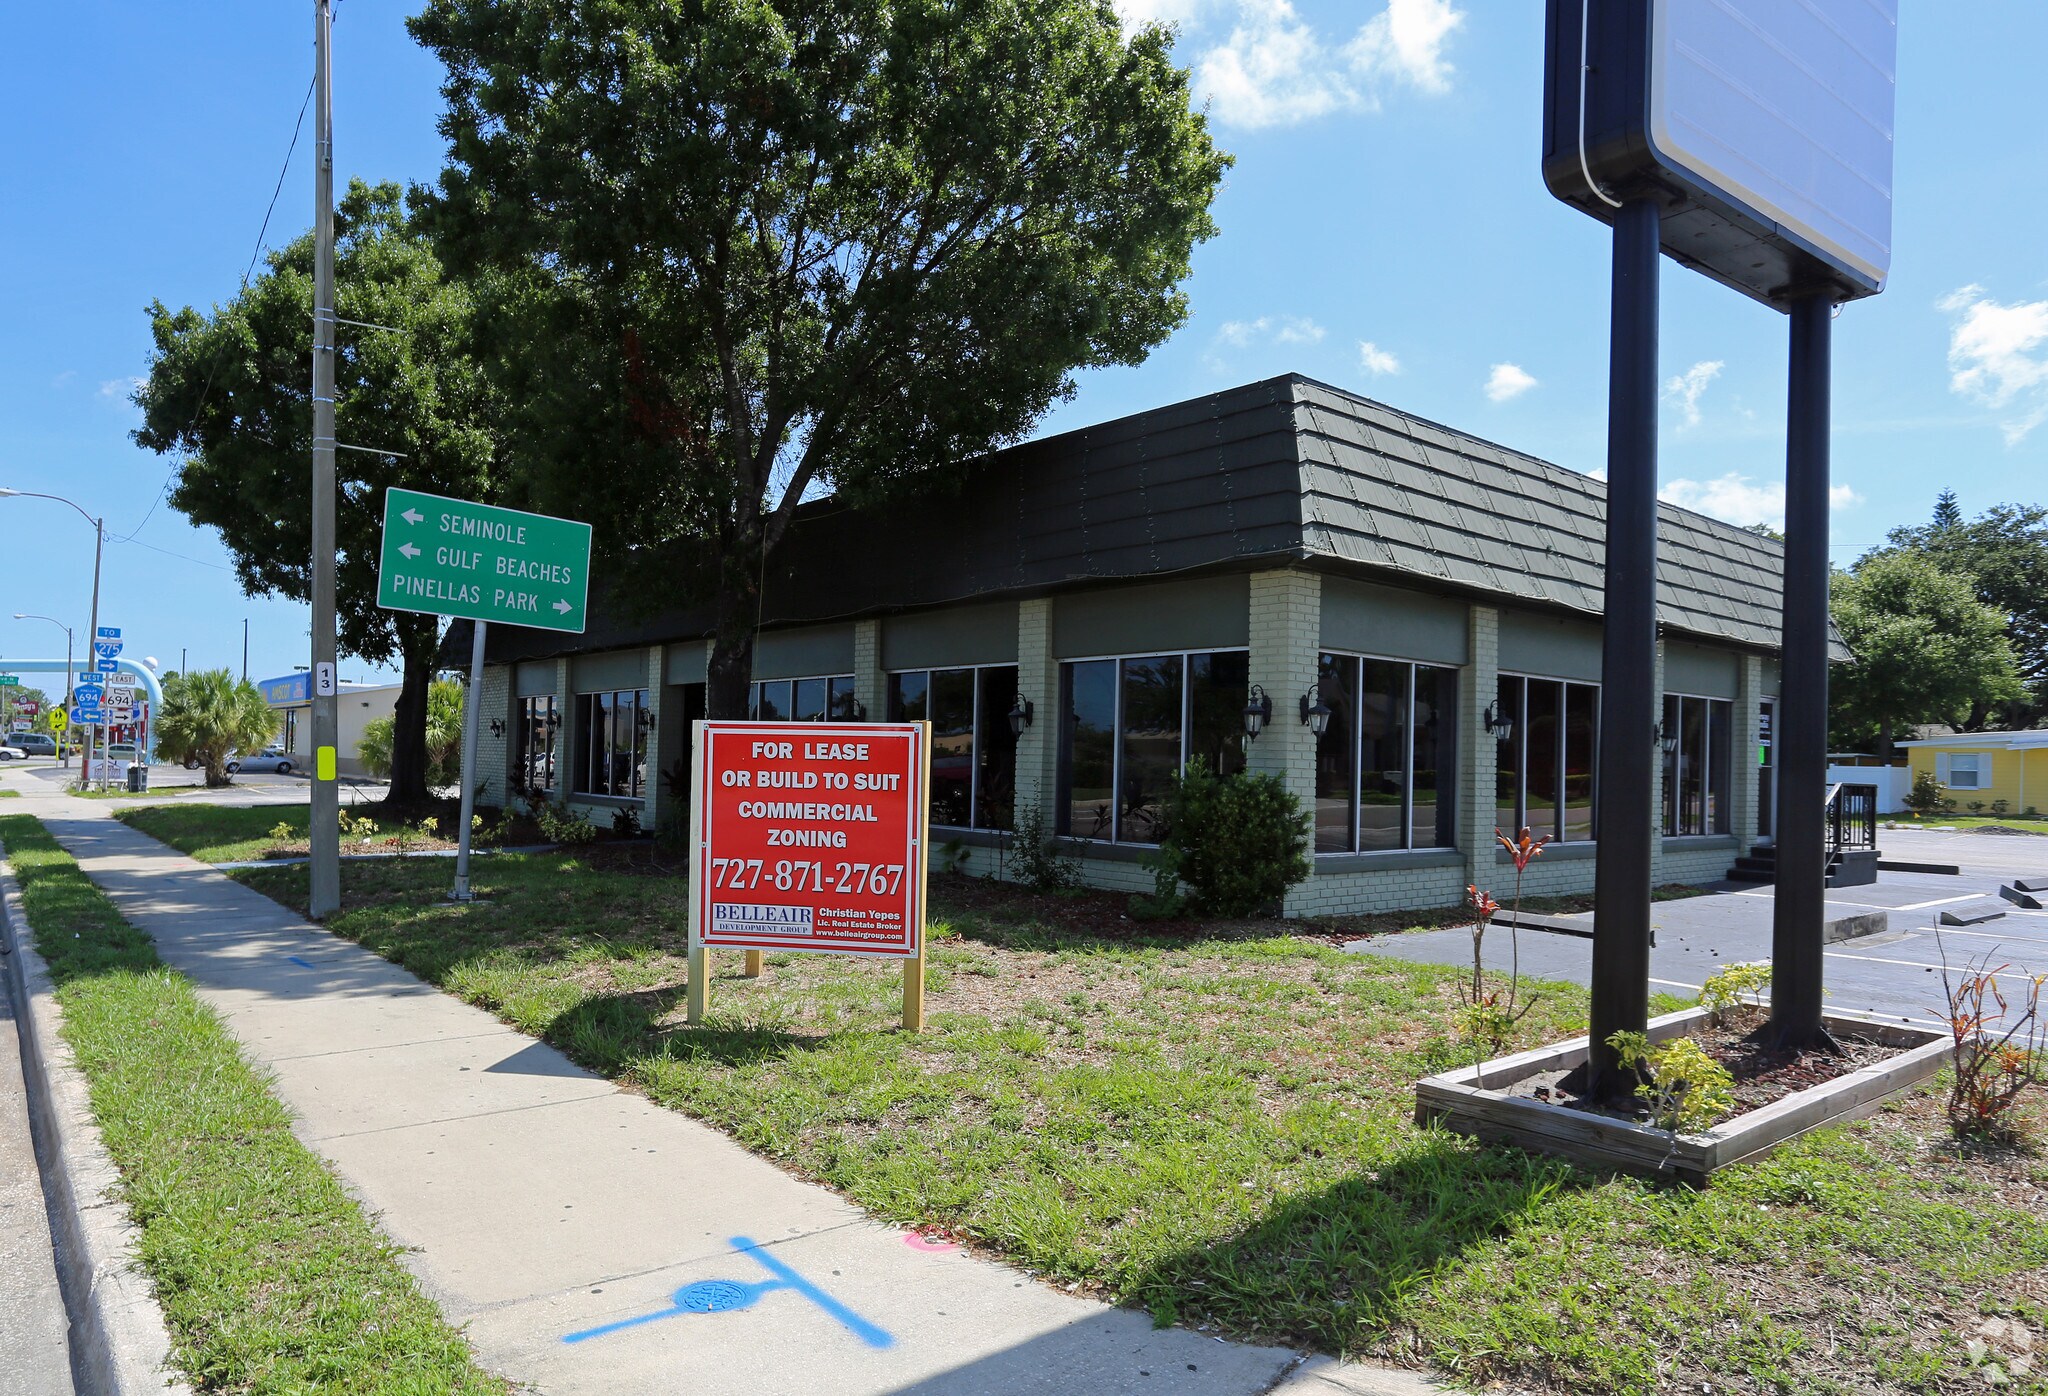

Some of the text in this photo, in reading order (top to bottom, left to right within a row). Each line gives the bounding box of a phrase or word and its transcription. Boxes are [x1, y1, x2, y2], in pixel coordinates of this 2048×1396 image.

[439, 513, 526, 545] SEMINOLE
[436, 547, 571, 585] GULF BEACHES
[393, 574, 538, 612] PINELLAS PARK
[99, 643, 120, 655] 275
[79, 693, 98, 702] 694
[107, 695, 129, 706] 694
[752, 741, 869, 761] FOR LEASE
[721, 769, 900, 791] OR BUILD TO SUIT
[738, 801, 878, 822] COMMERCIAL
[767, 829, 847, 848] ZONING
[712, 858, 904, 895] 727-871-2767
[715, 904, 812, 923] BELLEAIR
[819, 907, 900, 921] Christian Yepes
[719, 923, 808, 934] DEVELOPMENT GROUP
[815, 929, 903, 940] www.belleairgroup.com
[817, 919, 902, 931] Lic. Real Estate Broker
